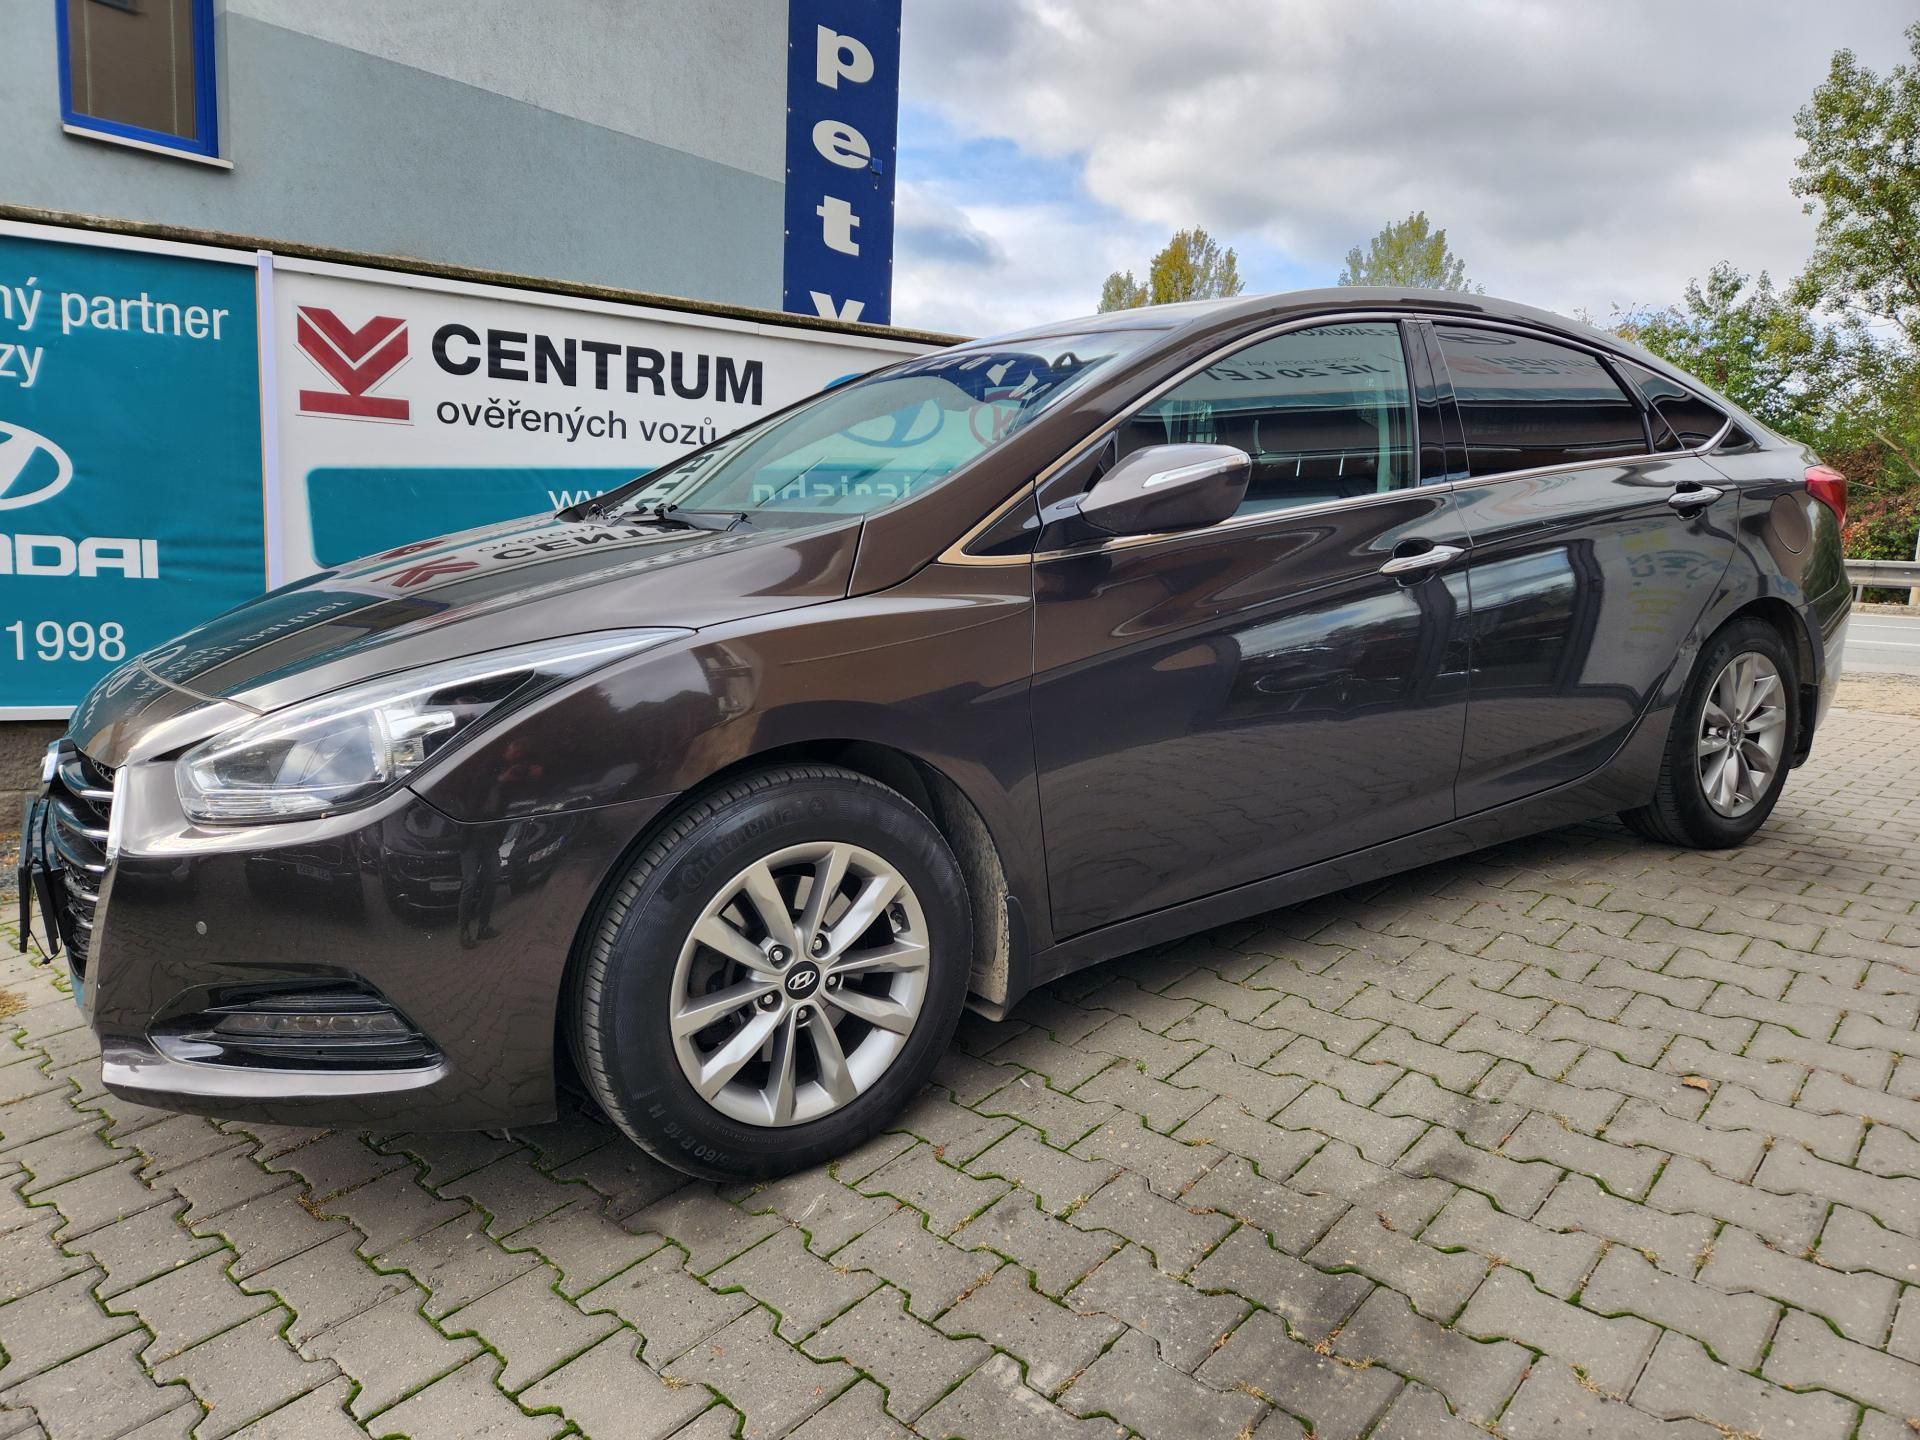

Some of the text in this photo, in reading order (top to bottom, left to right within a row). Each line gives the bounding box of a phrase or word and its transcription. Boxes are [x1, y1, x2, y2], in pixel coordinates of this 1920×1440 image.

[61, 291, 229, 340] partner
[431, 323, 764, 406] CENTRUM
[436, 397, 717, 446] ověřených vozů
[0, 533, 160, 579] DAI
[5, 620, 127, 663] 1998
